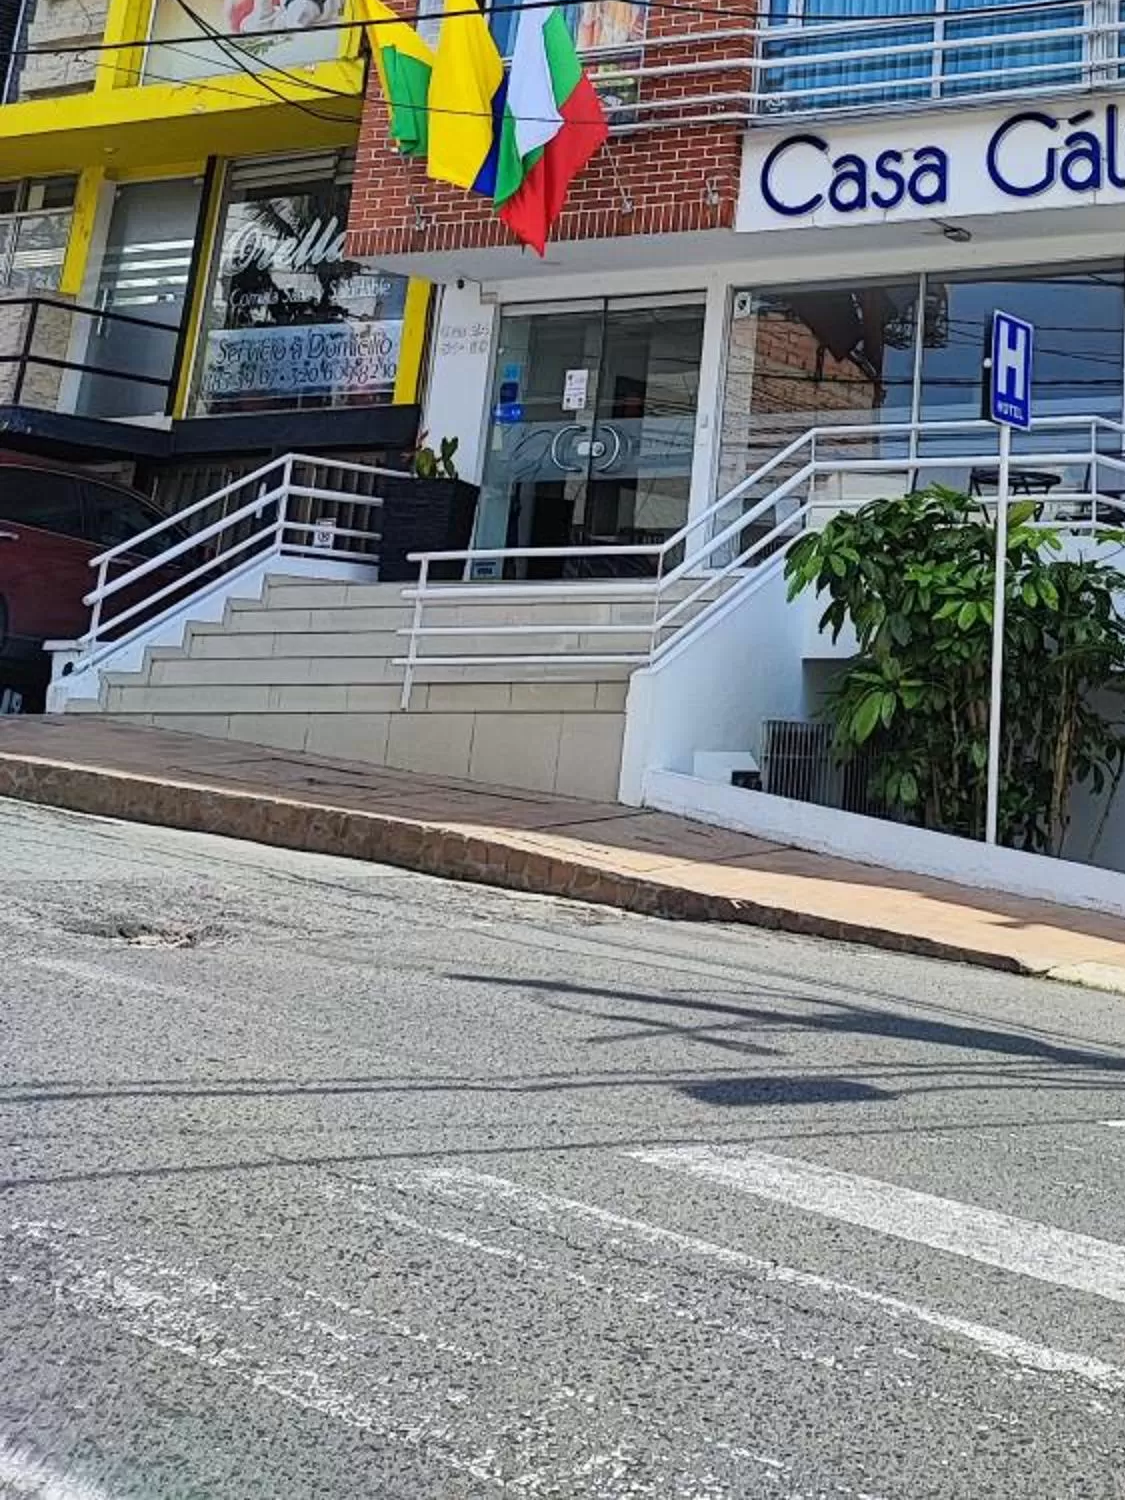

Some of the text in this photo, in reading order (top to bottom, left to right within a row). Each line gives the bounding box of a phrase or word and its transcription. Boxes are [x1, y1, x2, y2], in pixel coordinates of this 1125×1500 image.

[760, 134, 948, 217] Casa
[215, 337, 287, 364] Servicio
[308, 329, 394, 360] Domicilio
[997, 319, 1026, 401] H
[997, 399, 1025, 422] HOTEL
